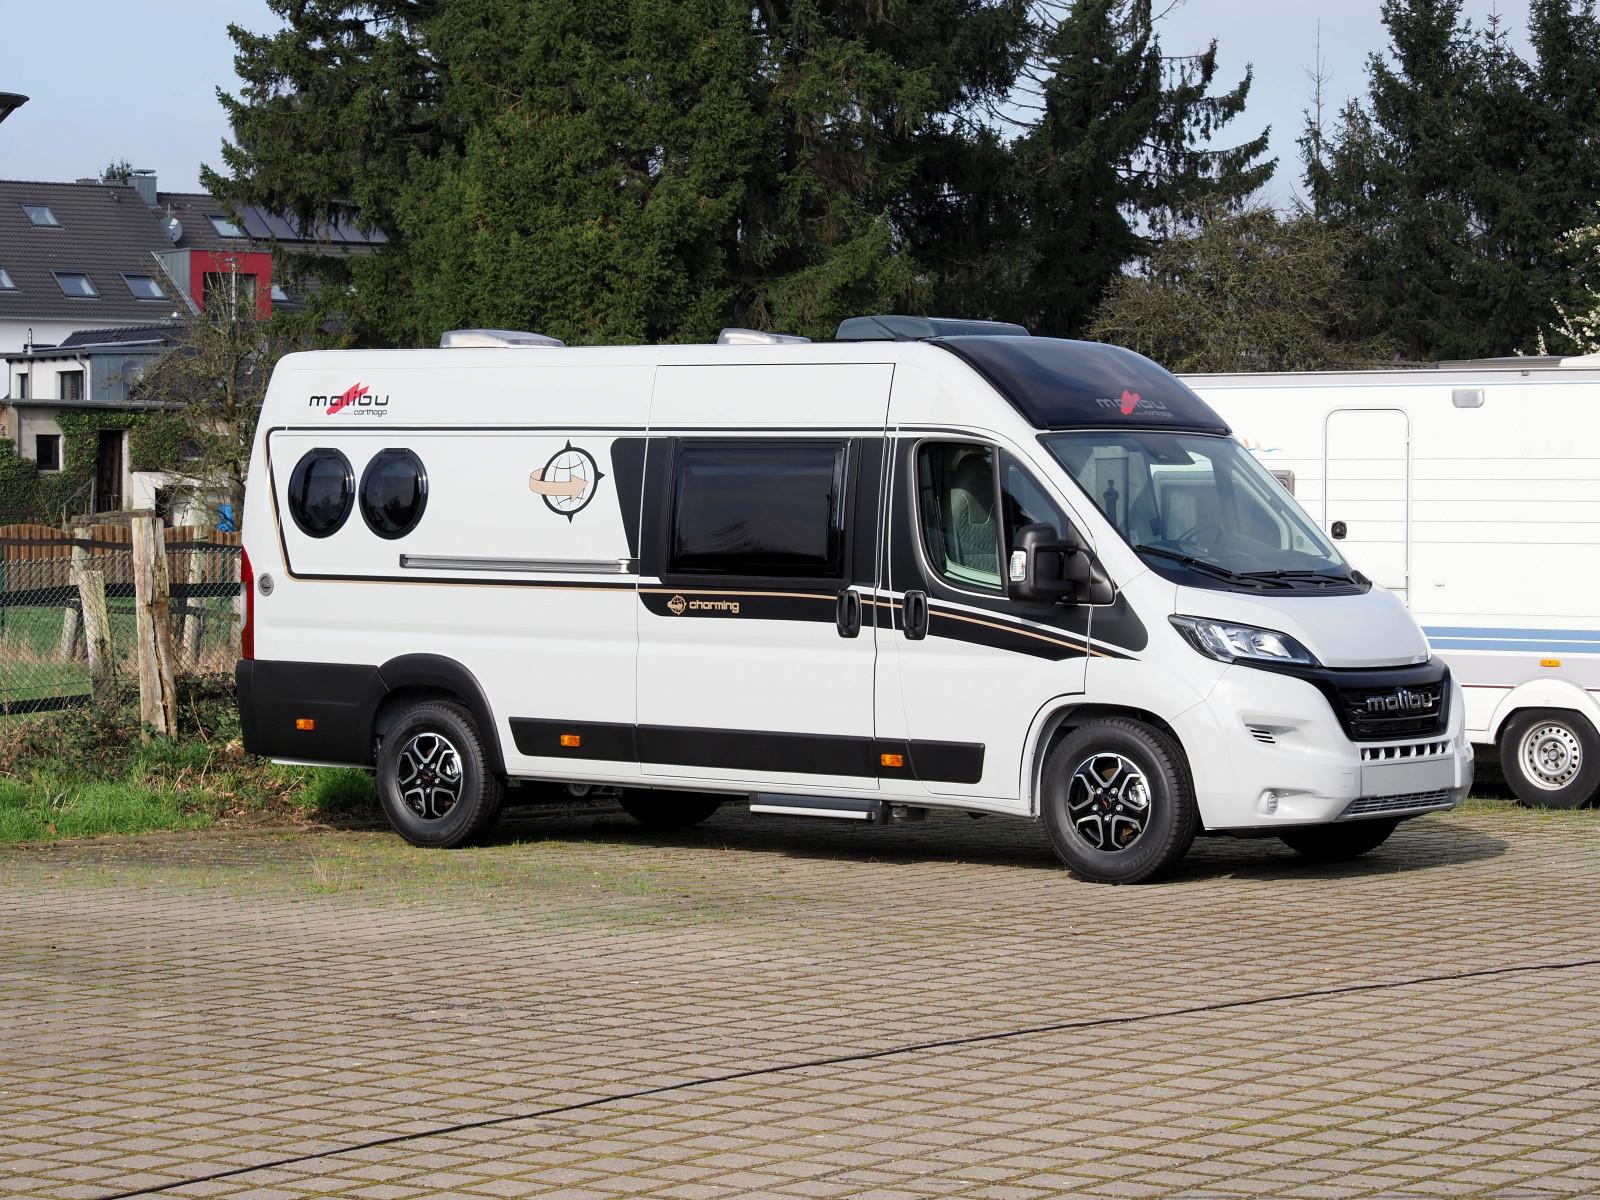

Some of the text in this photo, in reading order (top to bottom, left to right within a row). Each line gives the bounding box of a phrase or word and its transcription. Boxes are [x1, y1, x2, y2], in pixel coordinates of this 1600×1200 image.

[309, 390, 389, 406] malibu
[1096, 397, 1167, 410] maibu
[354, 409, 387, 417] carthago
[689, 600, 739, 613] charming
[1367, 690, 1433, 711] malibu
